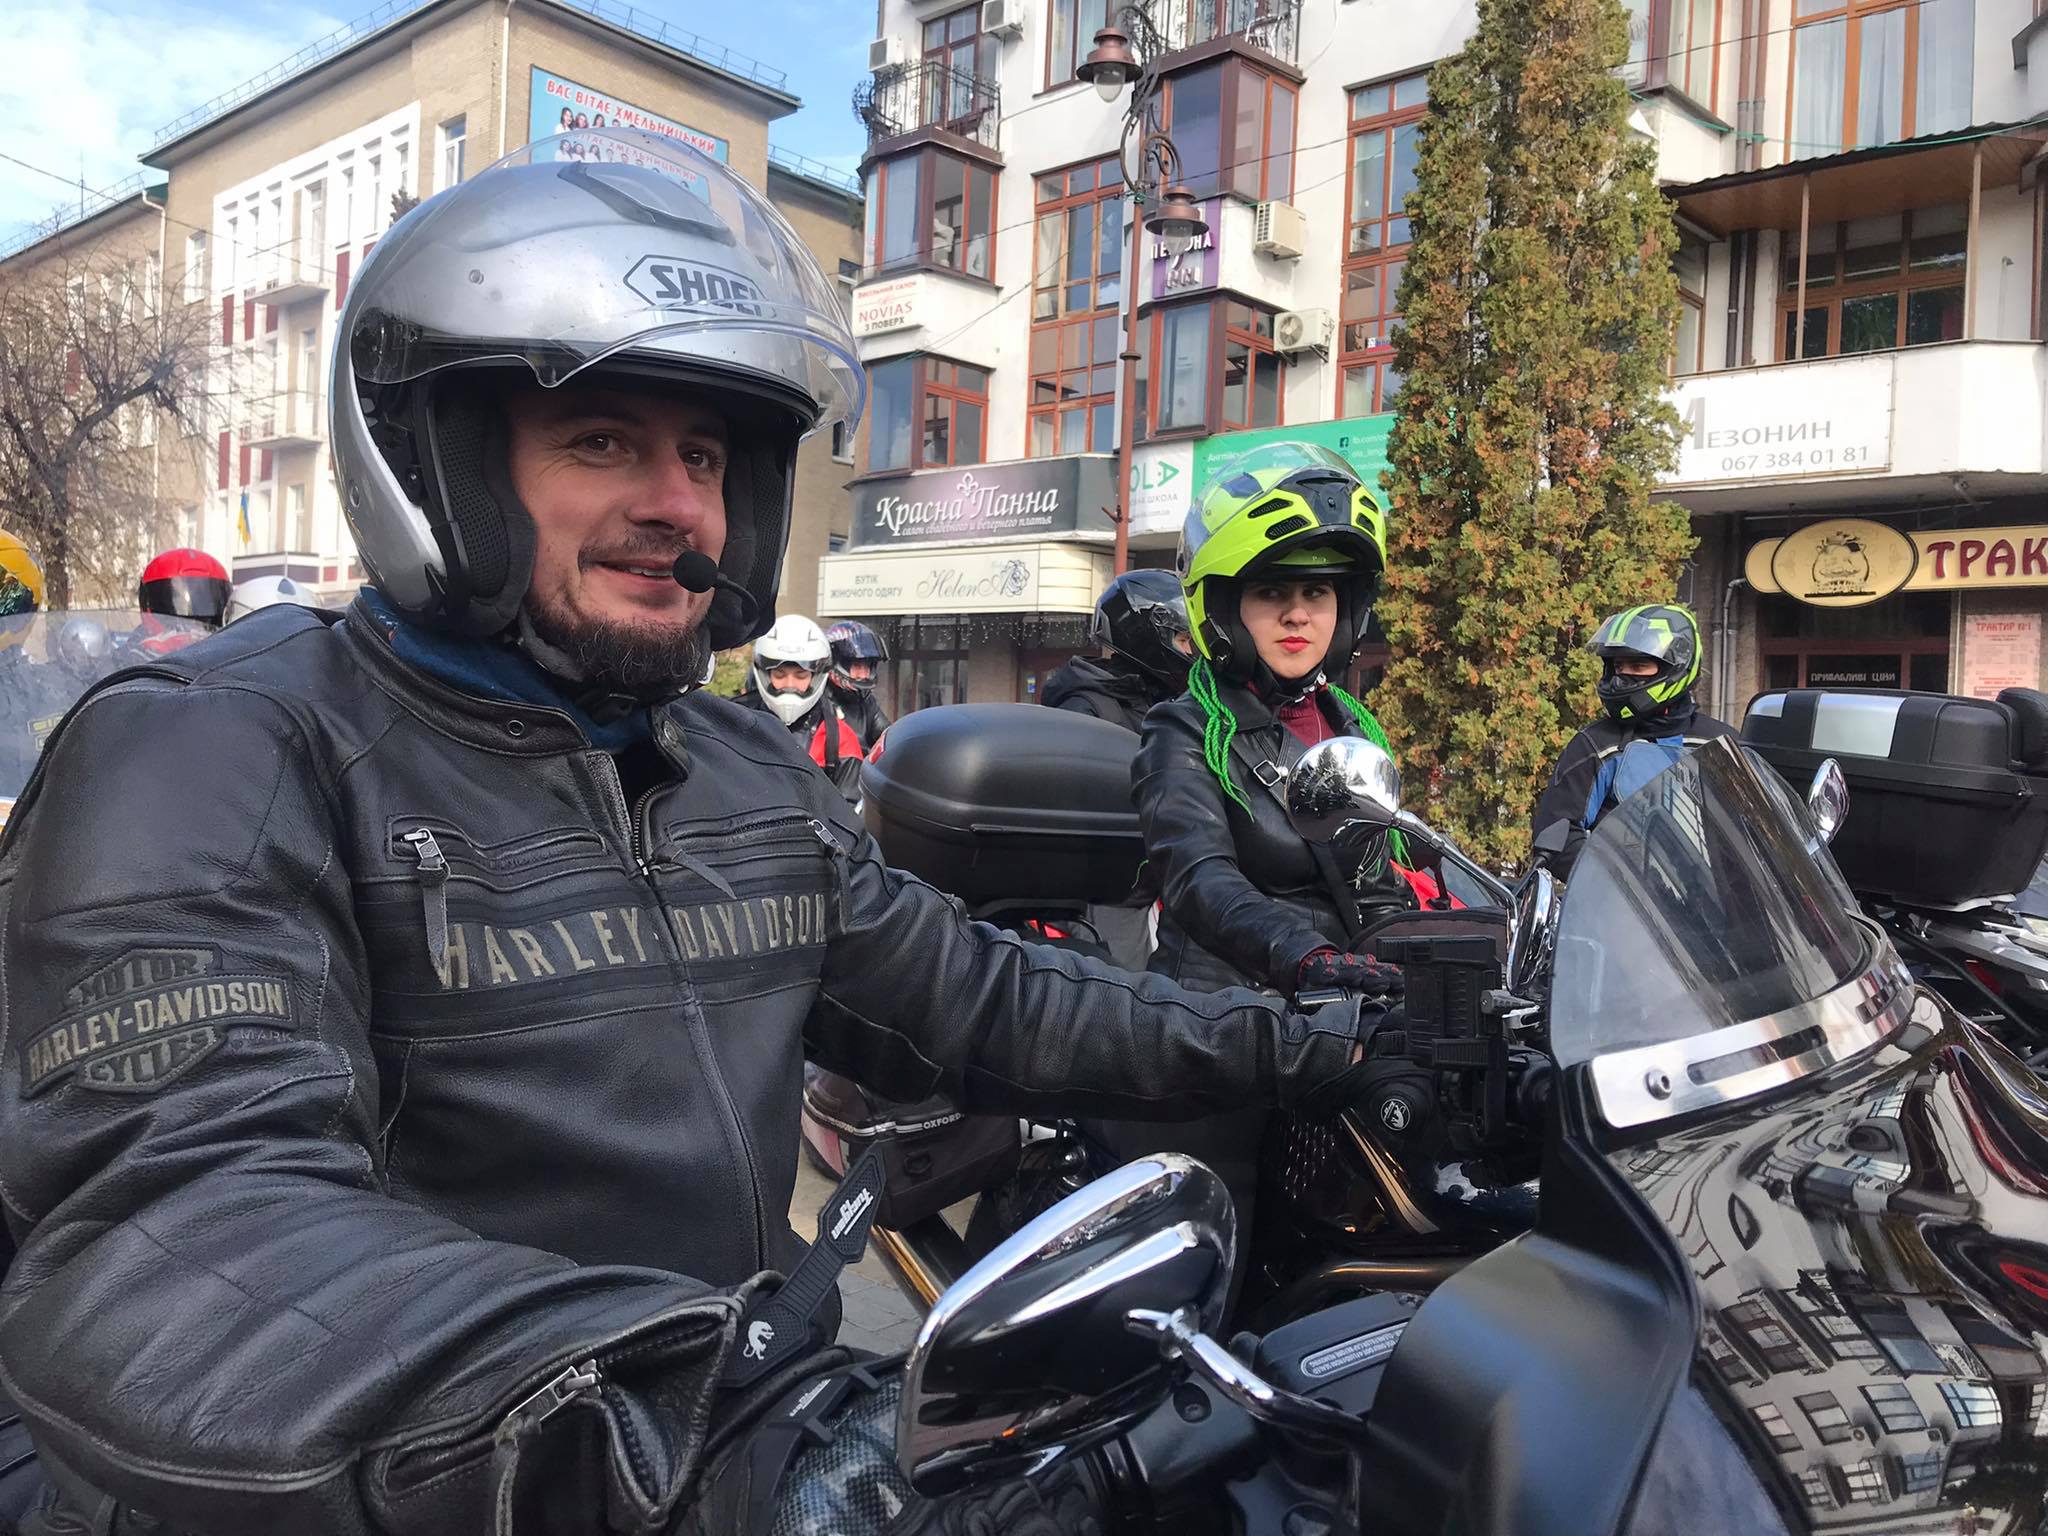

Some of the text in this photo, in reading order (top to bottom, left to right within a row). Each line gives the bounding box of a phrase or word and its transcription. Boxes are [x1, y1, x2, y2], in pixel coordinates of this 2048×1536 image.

[547, 79, 570, 99] ВАС
[859, 301, 913, 322] NOVIAS
[872, 317, 904, 329] ПОВЕРХ
[1722, 445, 1869, 471] 067 384 01 81
[875, 485, 1059, 537] Красна Панна
[1927, 537, 2048, 578] ТРАК
[854, 575, 879, 585] БУТІК
[876, 587, 903, 598] ОДЯГУ
[79, 951, 199, 999] MOTOR
[29, 982, 286, 1082] HARLEY-DAVIDSON
[923, 1112, 961, 1130] OXFORD
